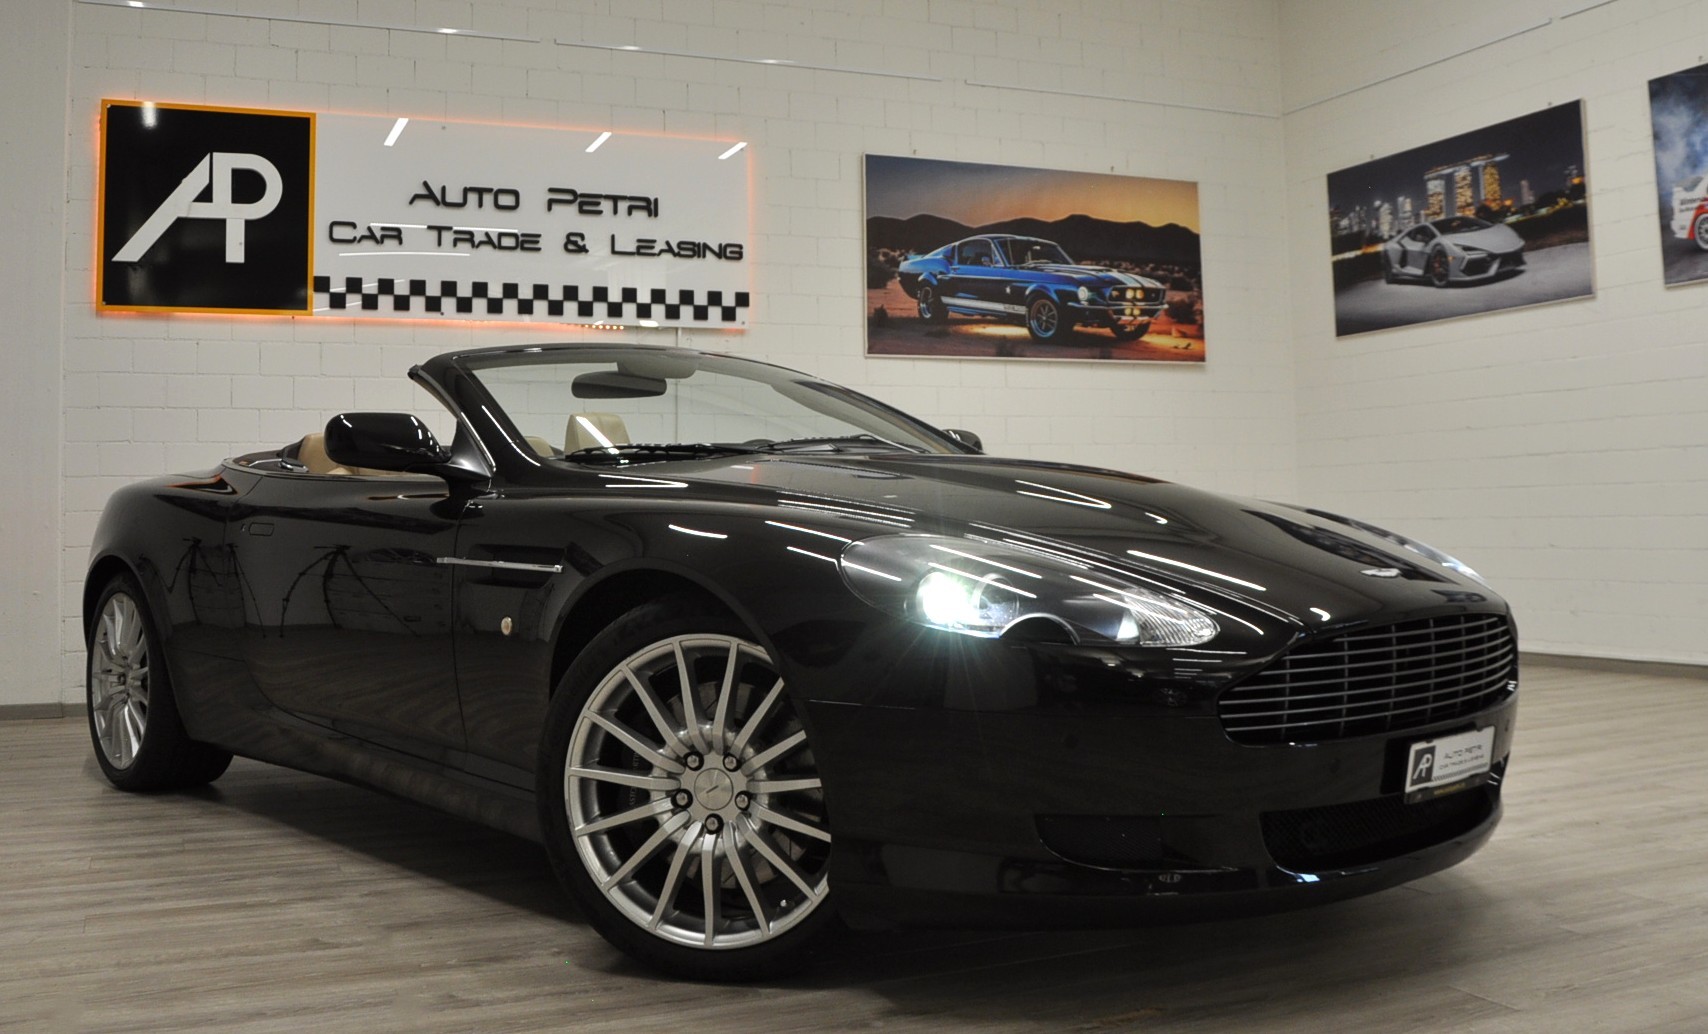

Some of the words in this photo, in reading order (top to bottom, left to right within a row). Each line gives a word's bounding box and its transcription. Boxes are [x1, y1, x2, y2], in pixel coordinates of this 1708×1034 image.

[408, 179, 520, 211] AUTO
[547, 187, 659, 218] PETRI
[328, 220, 403, 247] CAR
[426, 225, 542, 252] TRADE
[563, 231, 590, 254] &
[610, 233, 744, 261] LEASING
